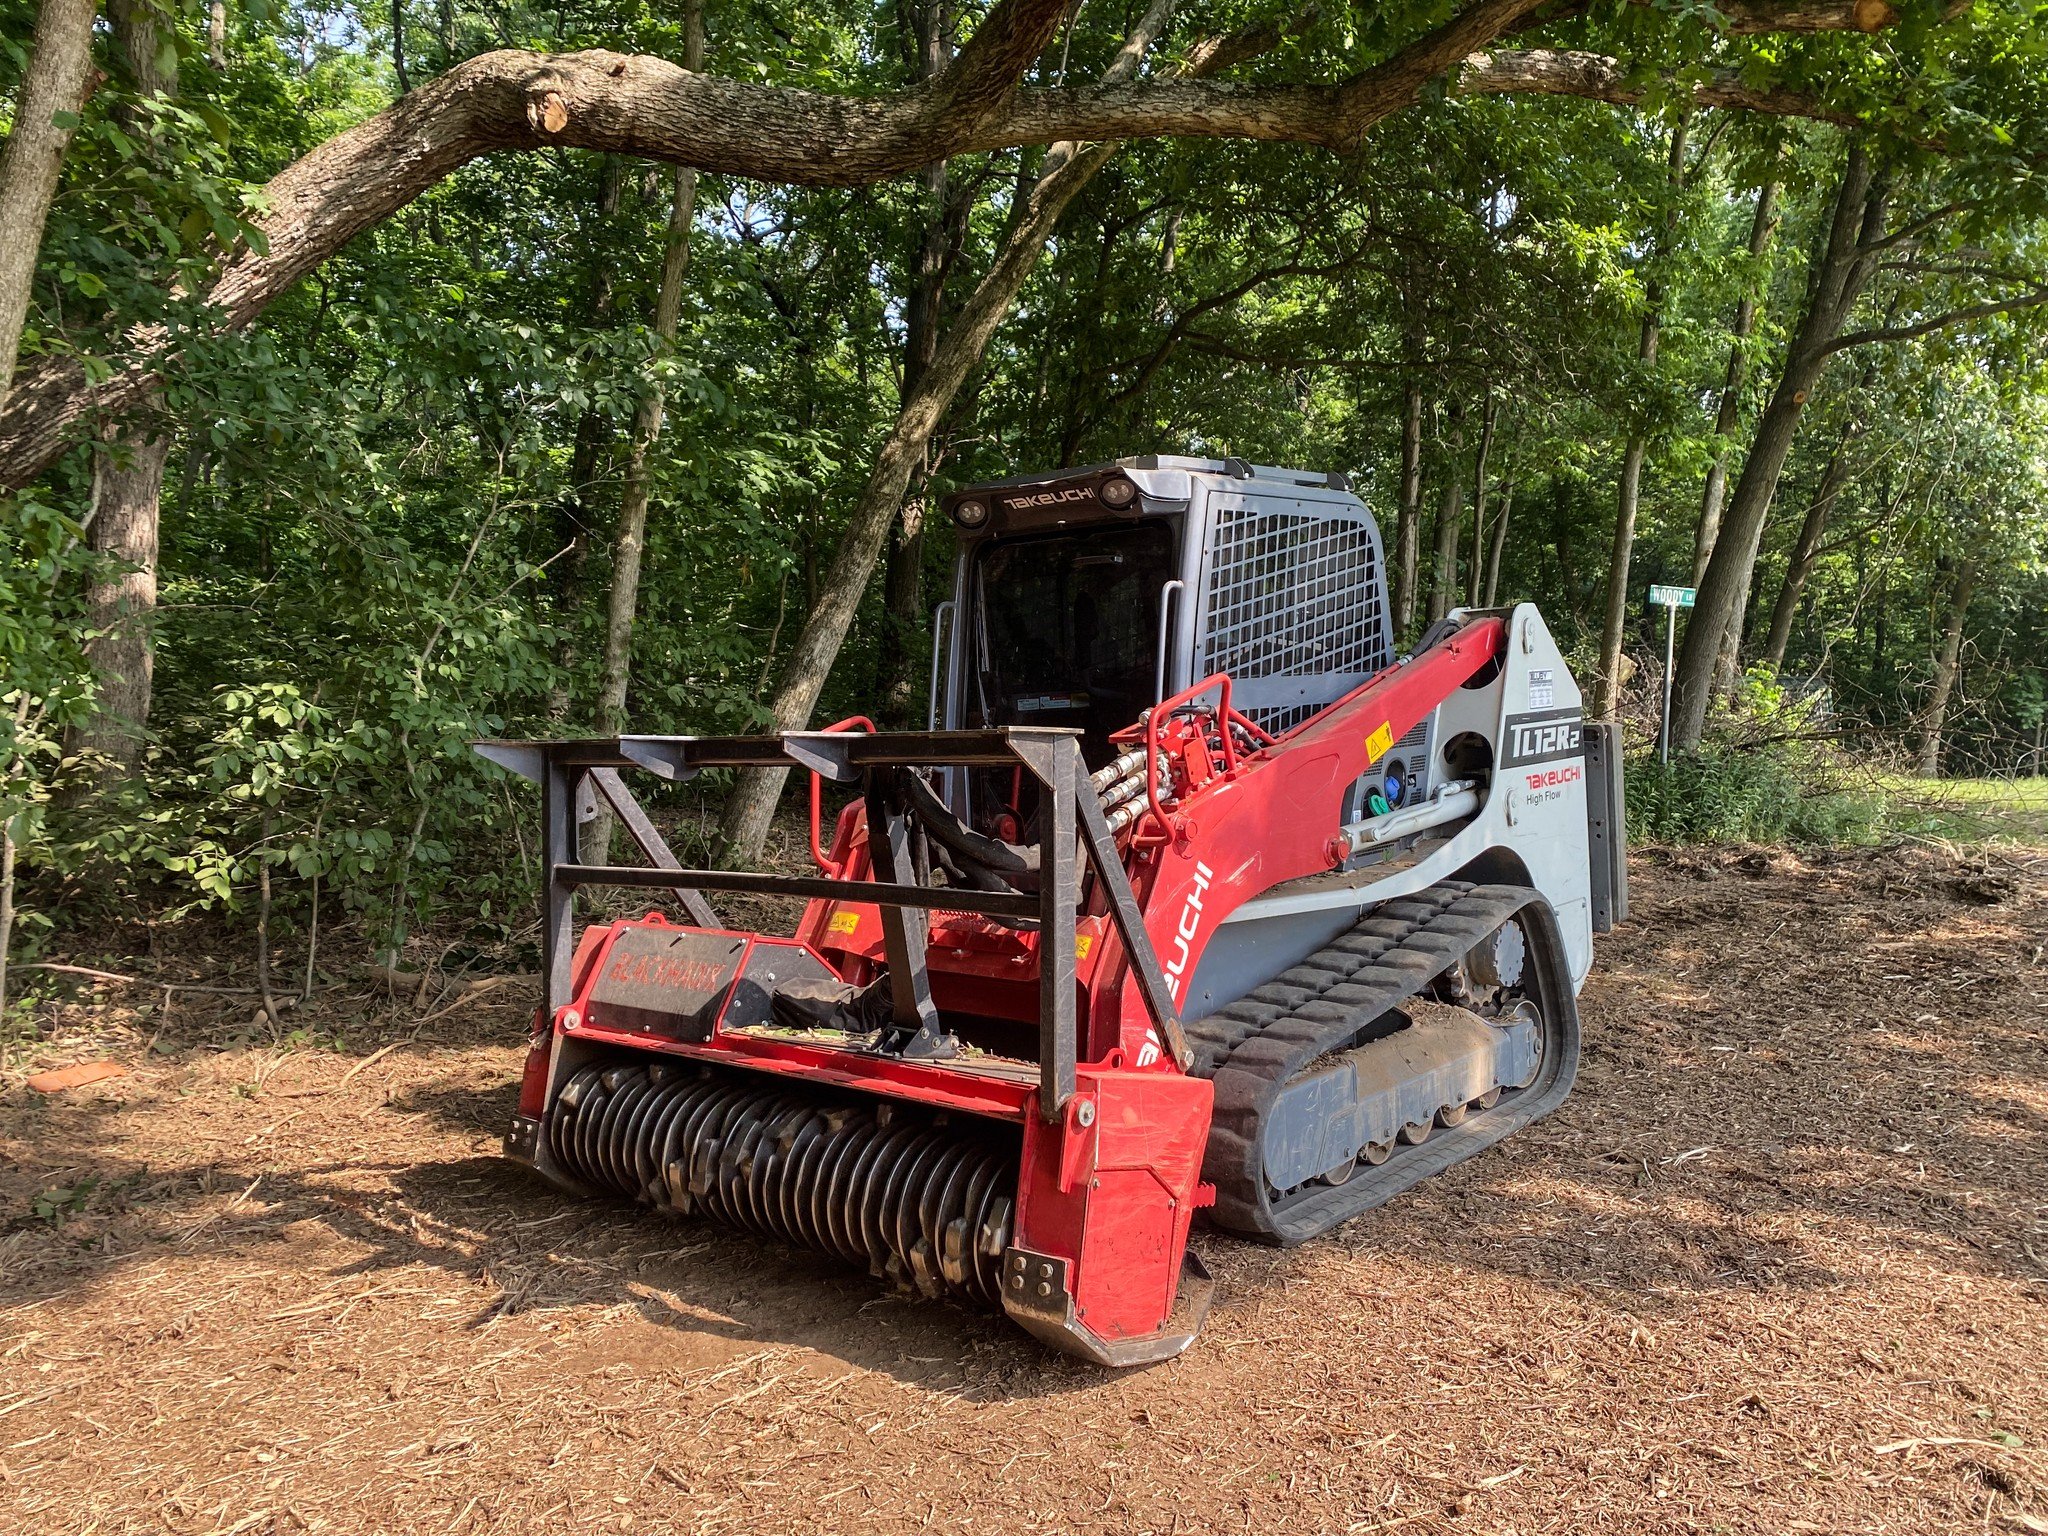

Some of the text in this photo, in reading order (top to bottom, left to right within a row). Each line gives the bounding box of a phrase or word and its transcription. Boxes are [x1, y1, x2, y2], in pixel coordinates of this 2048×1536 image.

[1653, 587, 1685, 603] WOODY
[1510, 716, 1582, 758] TL12R2
[1526, 789, 1561, 806] High Flow
